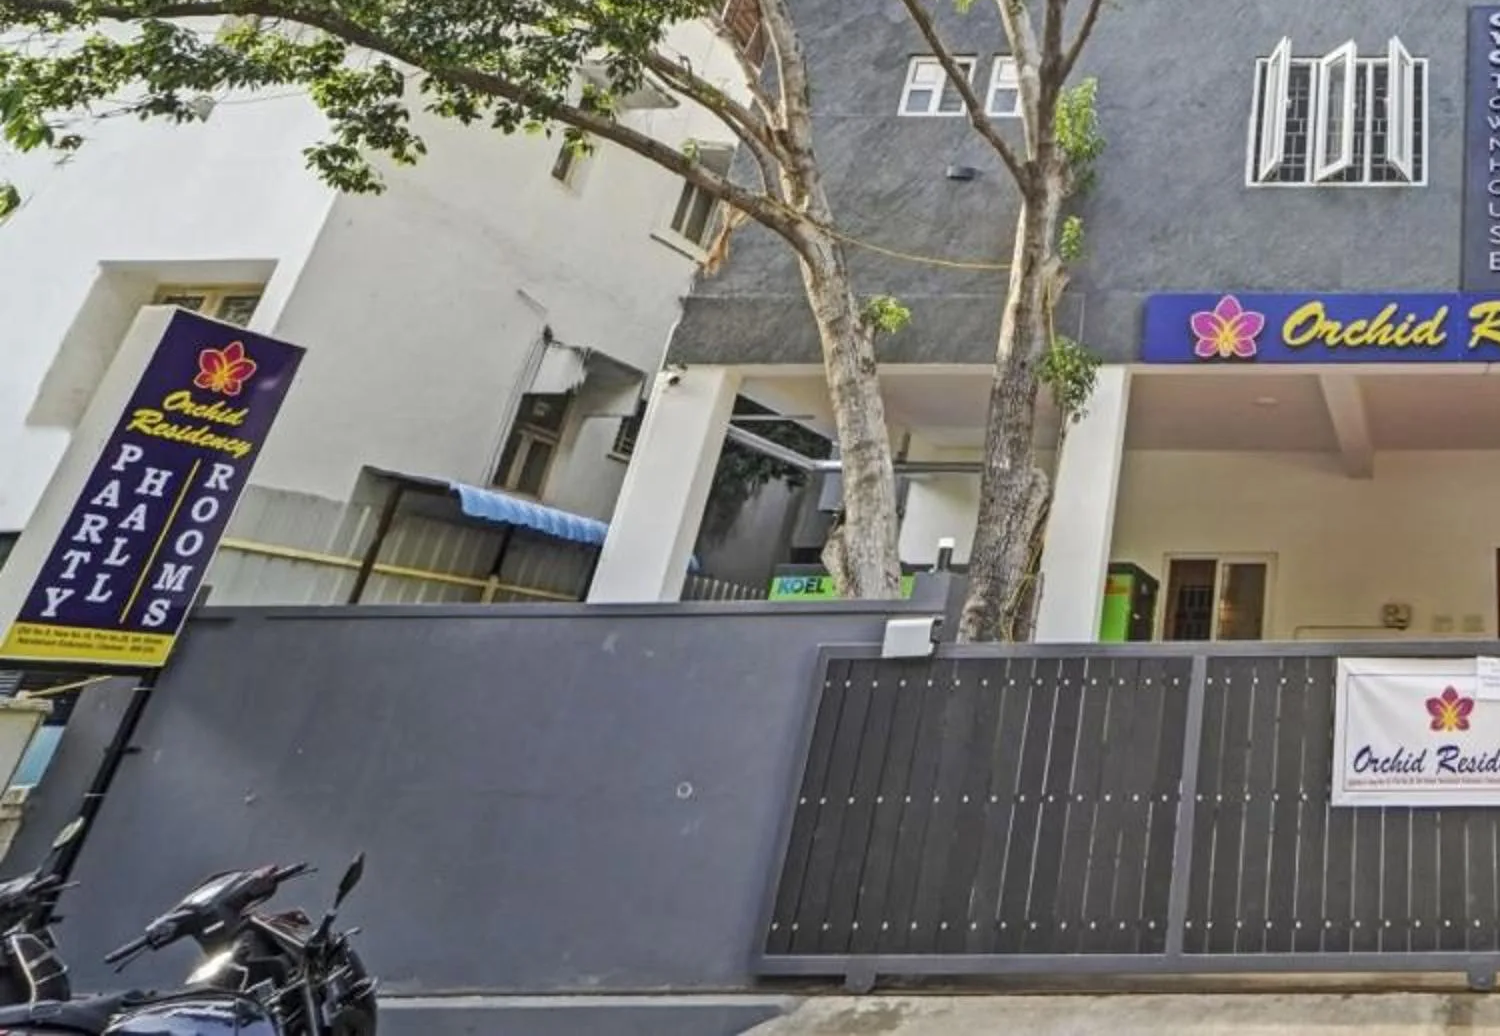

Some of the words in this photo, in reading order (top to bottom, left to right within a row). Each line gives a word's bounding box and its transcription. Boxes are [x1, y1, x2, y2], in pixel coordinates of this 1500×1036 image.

[1282, 300, 1448, 348] Orchid
[163, 391, 244, 425] Orchid
[127, 408, 254, 458] Residency
[41, 443, 143, 618] PARTY
[86, 467, 172, 603] HALL
[142, 463, 235, 627] ROOMS
[777, 577, 825, 595] KOEL
[1353, 745, 1427, 774] Orchid
